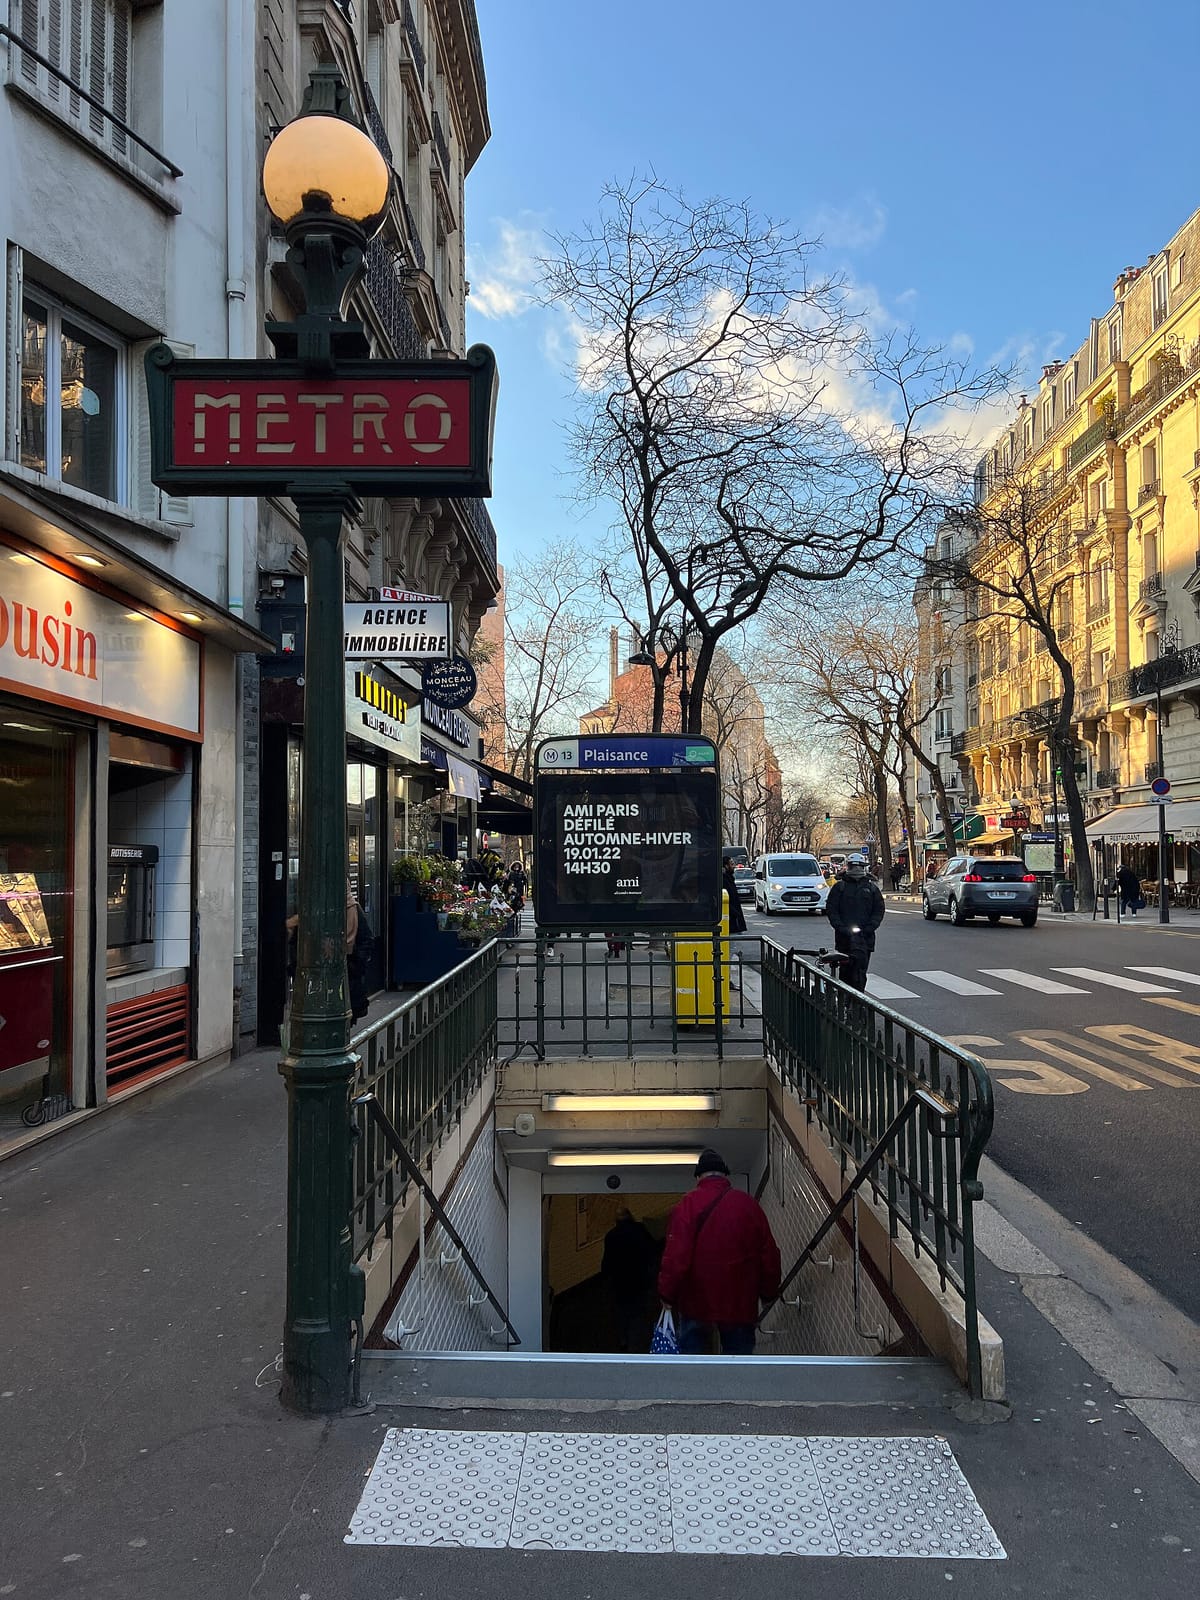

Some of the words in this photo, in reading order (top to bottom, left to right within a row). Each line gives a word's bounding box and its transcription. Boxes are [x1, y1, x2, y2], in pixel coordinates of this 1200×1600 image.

[194, 393, 452, 453] METRO
[362, 609, 428, 625] AGENCE
[426, 675, 472, 685] MONCEAU
[561, 751, 573, 760] 13
[584, 749, 649, 762] Plaisance
[564, 805, 593, 817] AMI
[597, 804, 639, 817] PARIS
[564, 817, 615, 831] DÉFILÉ
[563, 832, 692, 846] AUTOMNE-HIVER
[110, 848, 143, 858] ROTISSERIE
[564, 847, 621, 860] 19.01.22
[563, 861, 611, 874] 14H30
[616, 876, 640, 888] ami
